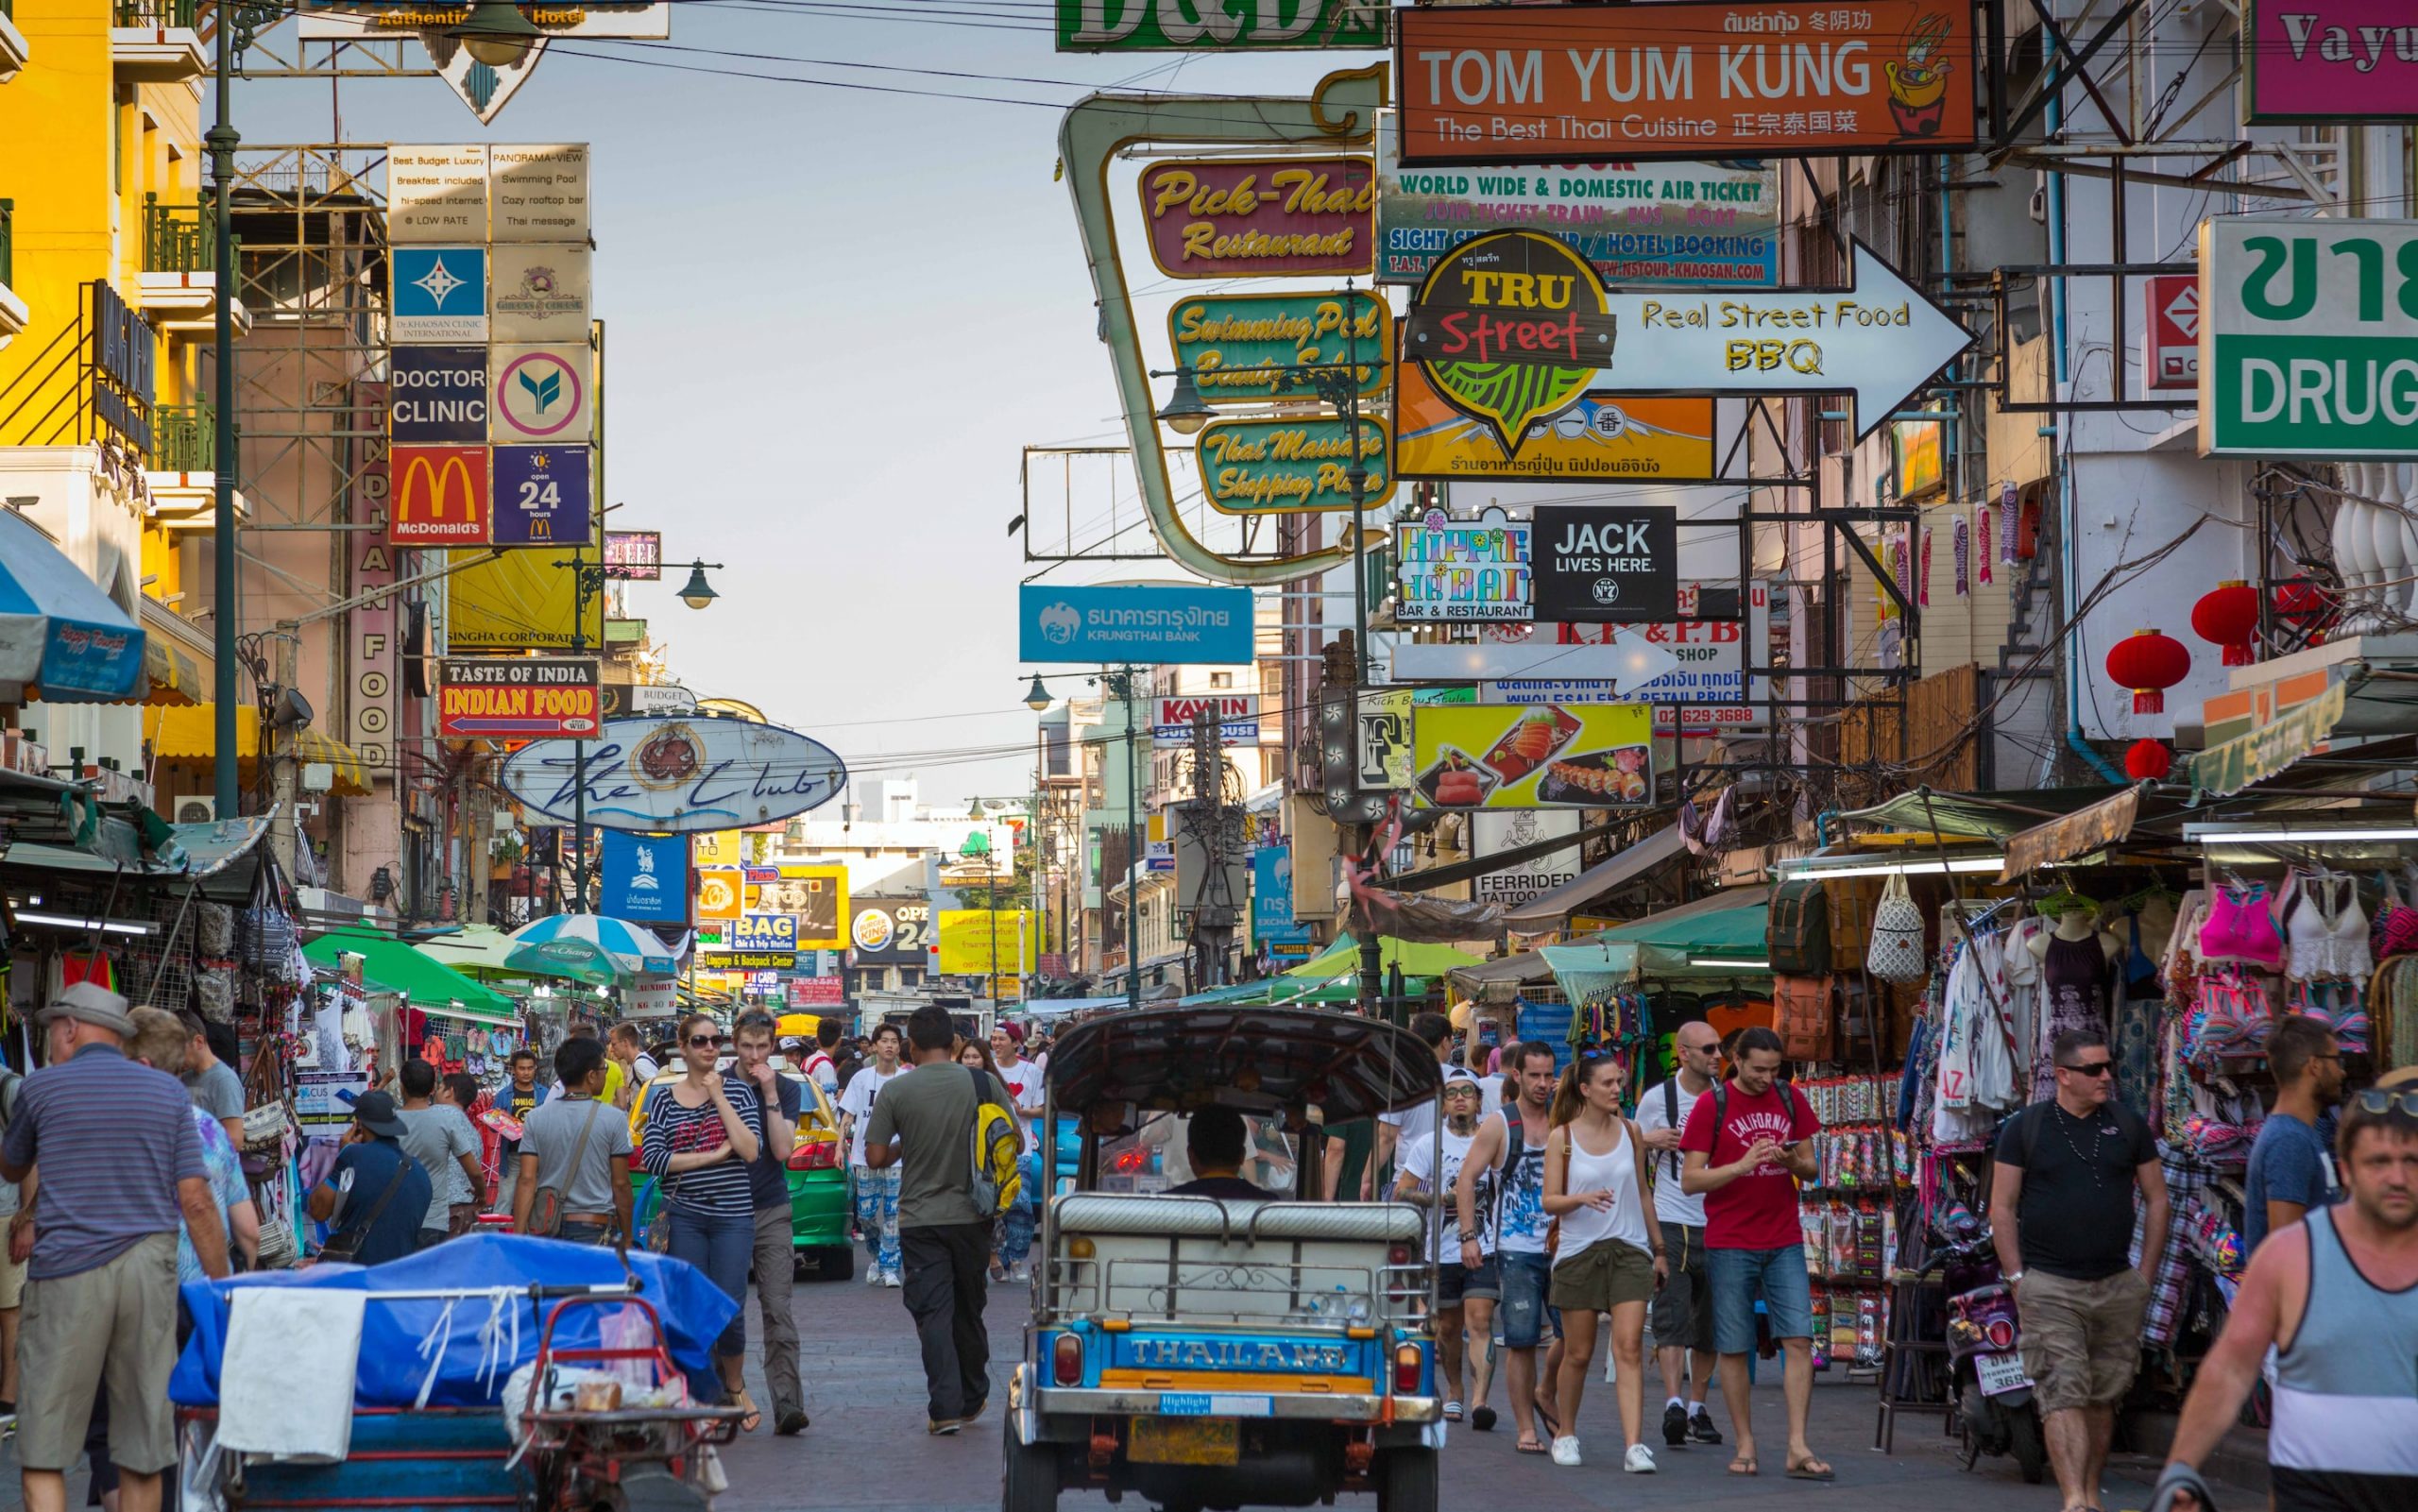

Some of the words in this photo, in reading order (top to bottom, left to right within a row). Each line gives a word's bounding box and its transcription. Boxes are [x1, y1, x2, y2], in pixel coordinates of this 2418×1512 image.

[533, 8, 585, 24] Hotel
[1724, 13, 1800, 36] ต้มยำกุ้ง
[1808, 10, 1872, 32] 冬阴功
[1419, 49, 1543, 105] TOM
[1567, 45, 1694, 102] YUM
[1720, 42, 1872, 98] KUNG
[1435, 116, 1481, 141] The
[1492, 115, 1548, 141] Best
[1557, 114, 1612, 140] Thai
[1621, 112, 1717, 138] Cuisine
[1732, 110, 1858, 137] 正宗泰国菜
[418, 158, 450, 166] Budget
[454, 158, 484, 166] Luxury
[397, 177, 439, 185] Breakfast
[445, 177, 484, 185] included
[502, 175, 552, 185] Swimming
[556, 175, 577, 183] Pool
[1400, 175, 1469, 195] WORLD
[1476, 177, 1526, 196] WIDE
[1536, 178, 1549, 196] &
[1559, 178, 1653, 198] DOMESTIC
[1661, 179, 1694, 199] AIR
[1700, 181, 1762, 202] TICKET
[401, 196, 442, 206] hi-speed
[446, 196, 484, 205] internet
[502, 196, 524, 206] Cozy
[529, 196, 564, 206] rooftop
[569, 196, 584, 205] bar
[1151, 168, 1373, 218] Pick-Thai
[532, 218, 575, 227] message
[1424, 202, 1470, 221] JOIN
[1477, 203, 1540, 223] TICKET
[1546, 204, 1604, 224] TRAIN
[1627, 206, 1662, 226] BUS
[1687, 207, 1737, 228] BOAT
[1182, 221, 1354, 261] Restaurant
[1389, 228, 1445, 249] SIGHT
[1608, 234, 1664, 256] HOTEL
[1674, 235, 1763, 258] BOOKING
[1462, 270, 1575, 310] TRU
[452, 320, 481, 329] CLINIC
[1179, 305, 1313, 349] Swimming
[1315, 301, 1378, 339] Pool
[1642, 300, 1709, 330] Real
[1719, 300, 1827, 329] Street
[1834, 299, 1911, 326] Food
[404, 330, 472, 338] INTERNATIONAL
[1440, 310, 1586, 364] Street
[1725, 338, 1823, 377] BBQ
[392, 370, 485, 387] DOCTOR
[392, 400, 485, 423] CLINIC
[1206, 433, 1267, 465] Thai
[1269, 430, 1382, 461] Massage
[519, 482, 561, 509] 24
[1217, 468, 1315, 504] Shopping
[397, 522, 480, 535] McDonald's
[1555, 523, 1651, 554] JACK
[614, 543, 657, 569] BEER
[1556, 557, 1602, 572] LIVES
[1088, 606, 1229, 632] ธนาคารกรุงไทย
[1398, 605, 1423, 617] BAR
[1430, 605, 1440, 617] &
[1447, 605, 1529, 617] RESTAURANT
[448, 632, 496, 642] SINGHA
[1088, 630, 1163, 642] KRUNGTHAI
[1166, 630, 1200, 642] BANK
[1645, 621, 1670, 642] &
[1677, 648, 1718, 662] SHOP
[450, 667, 505, 682] TASTE
[509, 667, 532, 682] OF
[537, 667, 587, 682] INDIA
[360, 634, 387, 769] FOOD
[444, 688, 528, 715] INDIAN
[533, 688, 593, 715] FOOD
[643, 689, 683, 701] BUDGET
[1368, 696, 1394, 705] Rich
[688, 758, 826, 807] Club
[860, 918, 886, 932] BURGER
[895, 907, 929, 922] OPE
[735, 916, 792, 936] BAG
[860, 926, 888, 942] KING
[557, 947, 593, 959] Chang
[706, 953, 732, 968] Luggage
[741, 954, 770, 968] Backpack
[772, 956, 793, 967] Center
[1728, 1113, 1792, 1138] CALIFORNIA
[1132, 1339, 1346, 1368] THAILAND
[1163, 1395, 1209, 1406] Highlight
